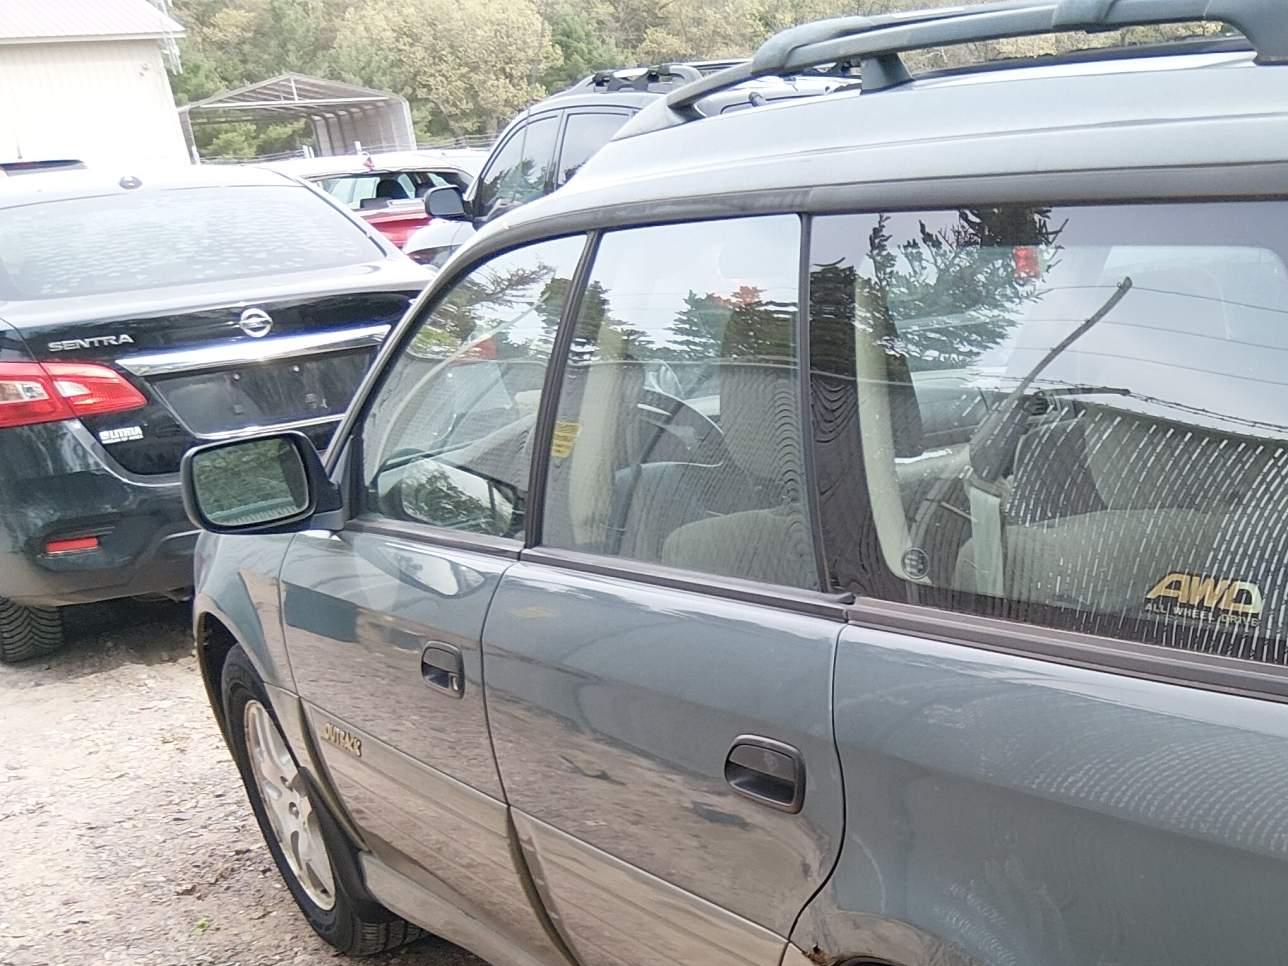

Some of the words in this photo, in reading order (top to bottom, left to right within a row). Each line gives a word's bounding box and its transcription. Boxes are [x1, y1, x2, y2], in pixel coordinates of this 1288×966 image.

[48, 334, 135, 352] SENTRA
[1145, 572, 1265, 614] AWD
[1144, 602, 1168, 614] ALL
[1173, 606, 1216, 621] WHEEL
[1220, 613, 1261, 627] DRIVE
